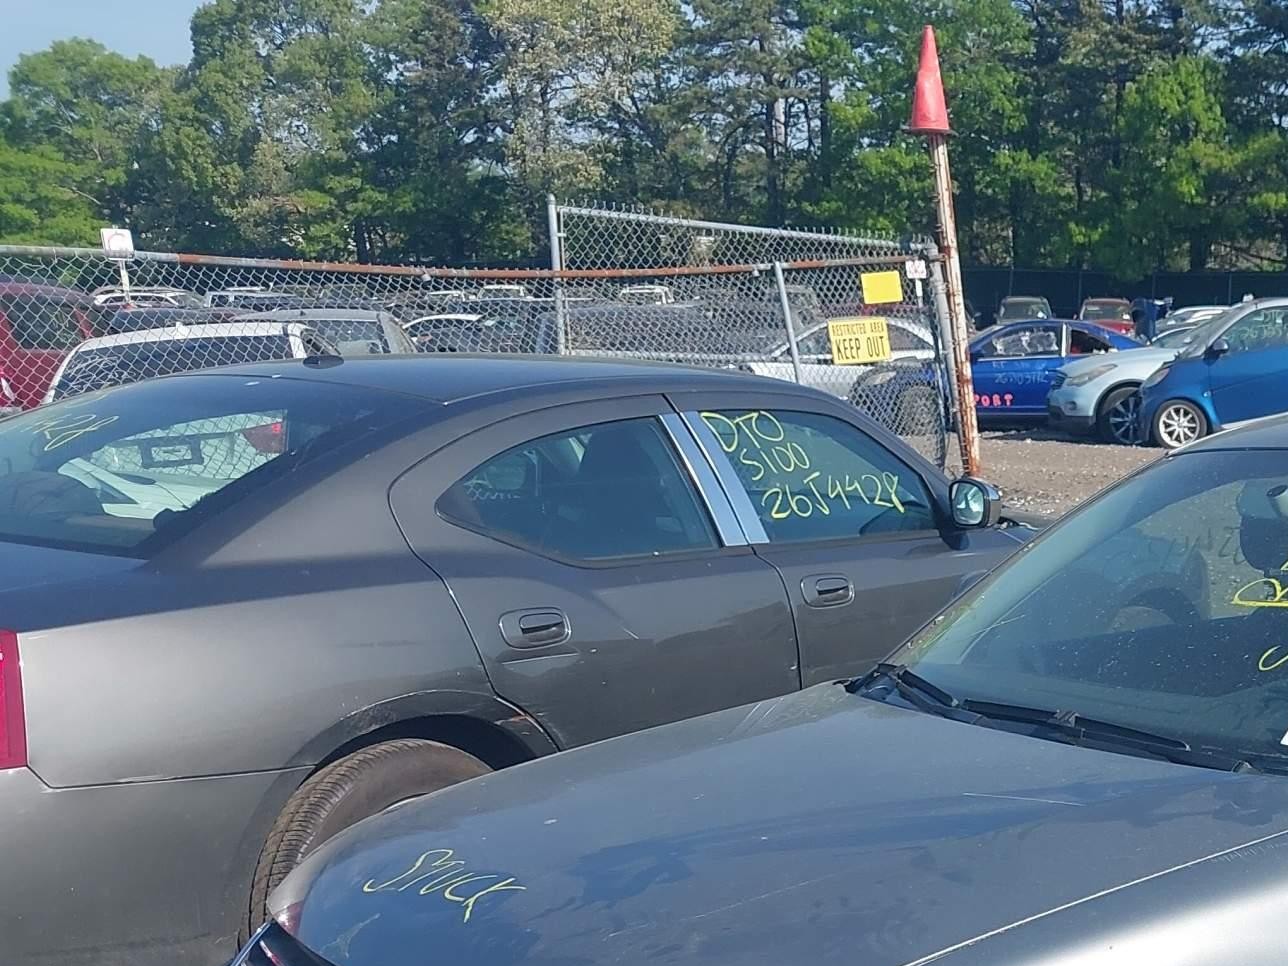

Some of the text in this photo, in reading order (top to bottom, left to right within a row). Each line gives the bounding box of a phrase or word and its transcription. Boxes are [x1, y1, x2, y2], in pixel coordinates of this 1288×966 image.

[831, 321, 885, 337] RESTRICTED AREA
[835, 336, 886, 361] KEEP OUT
